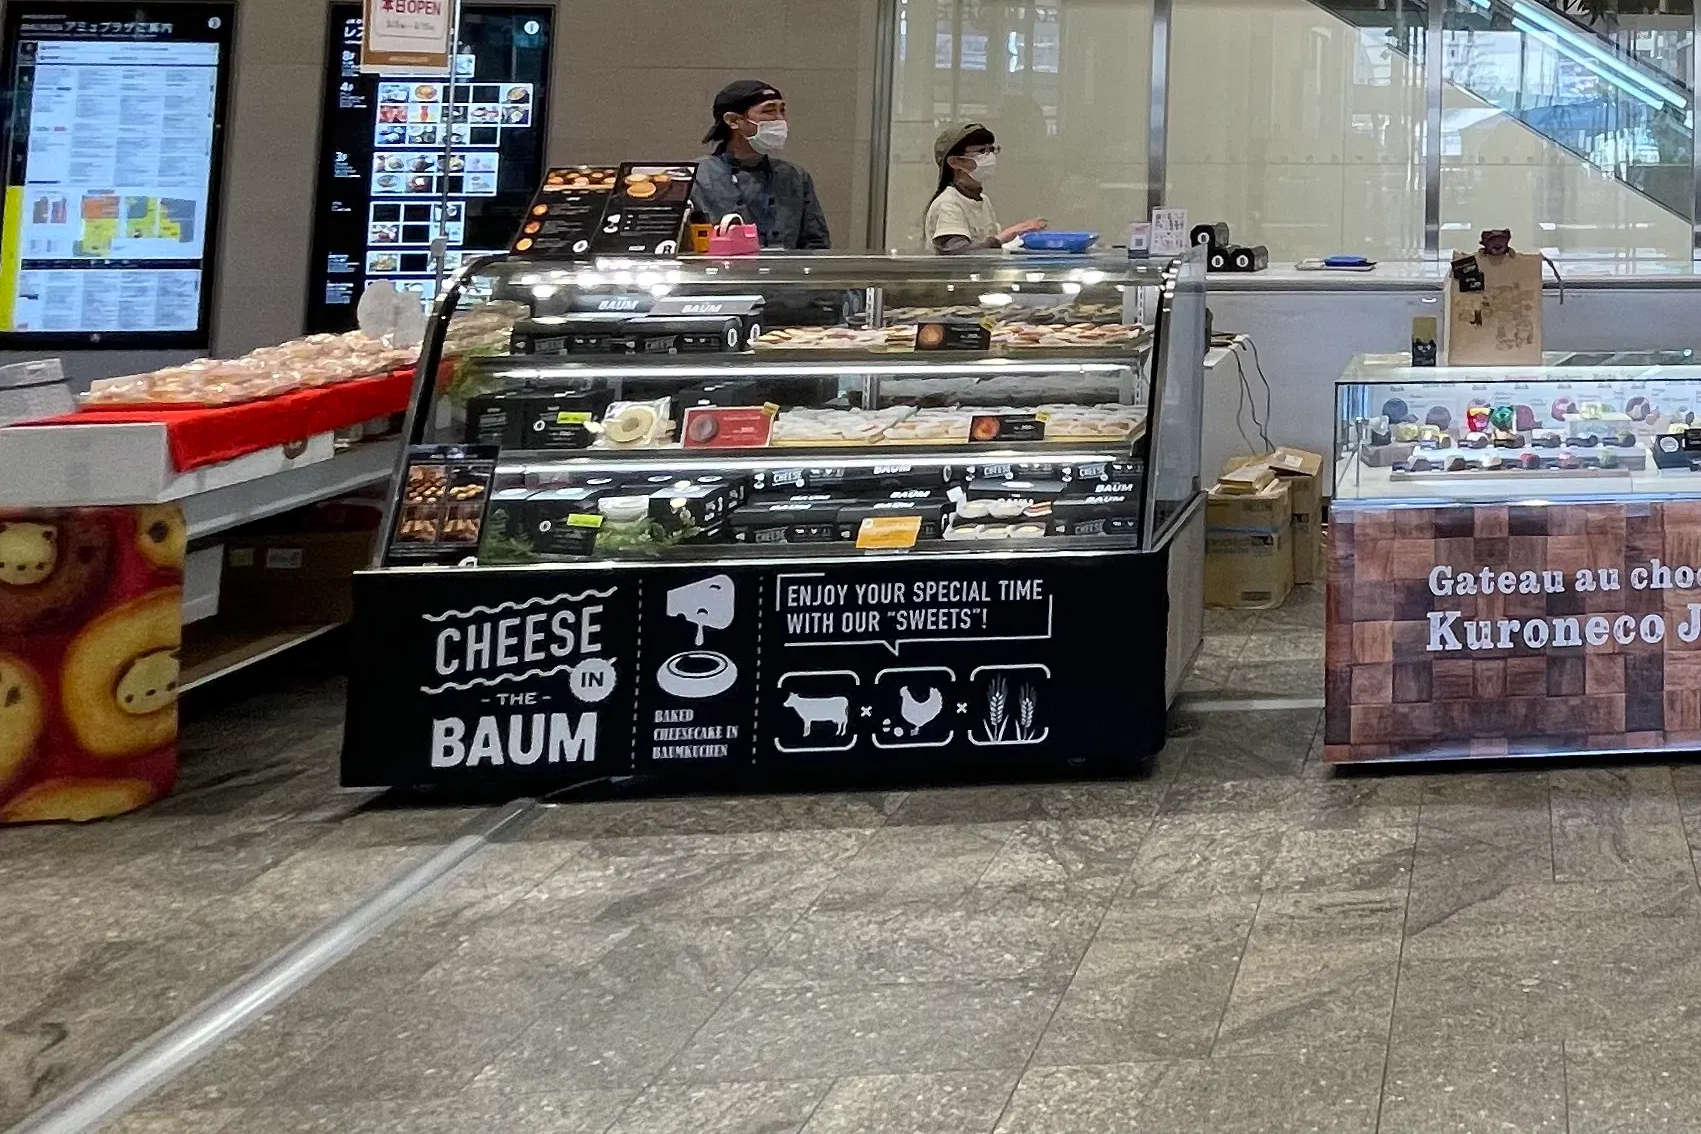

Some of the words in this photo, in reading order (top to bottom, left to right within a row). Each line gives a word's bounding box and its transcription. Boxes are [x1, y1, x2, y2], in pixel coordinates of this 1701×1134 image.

[598, 300, 640, 311] BAUM
[787, 584, 848, 607] ENJOY
[855, 582, 906, 606] YOUR
[912, 580, 991, 603] SPECIAL
[998, 579, 1044, 601] TIME
[1428, 565, 1565, 597] Gateau
[1574, 569, 1621, 593] au
[786, 612, 834, 635] WITH
[841, 610, 880, 633] OUR
[1425, 610, 1666, 652] Kuroneco
[435, 604, 604, 675] CHEESE
[580, 670, 604, 688] IN
[654, 708, 694, 723] BAKED
[431, 711, 598, 768] BAUM
[653, 725, 723, 741] CHEESECAKE
[726, 725, 739, 739] IN
[652, 744, 728, 759] BAUMKUCHEN
